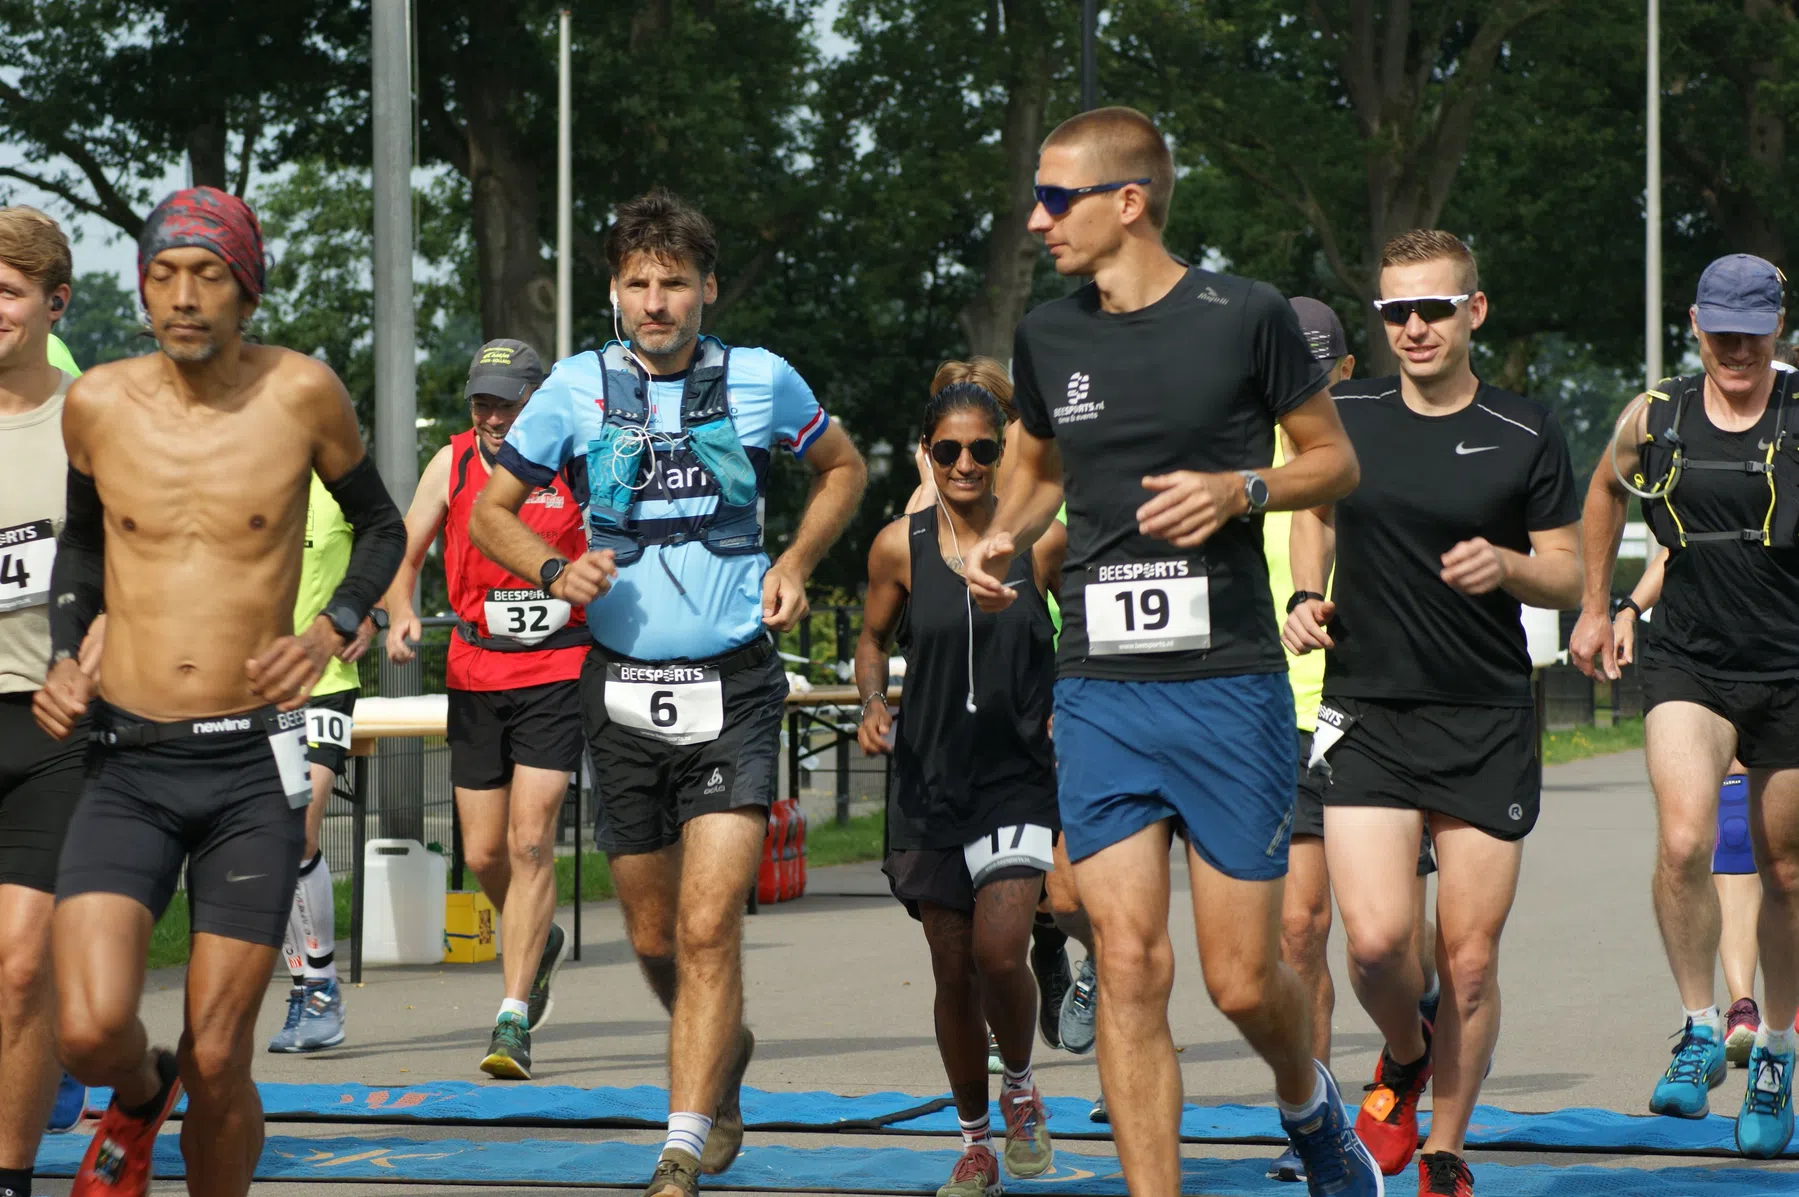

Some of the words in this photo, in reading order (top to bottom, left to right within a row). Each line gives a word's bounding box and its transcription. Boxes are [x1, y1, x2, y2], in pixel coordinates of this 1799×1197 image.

[0, 553, 30, 589] 4
[1099, 560, 1189, 582] BEESPORTS
[494, 589, 550, 601] BEESPOR
[507, 605, 550, 633] 32
[1115, 588, 1170, 631] 19
[621, 667, 704, 682] BEESPORTS
[650, 690, 677, 727] 6
[193, 718, 250, 734] newline
[311, 714, 343, 742] 10
